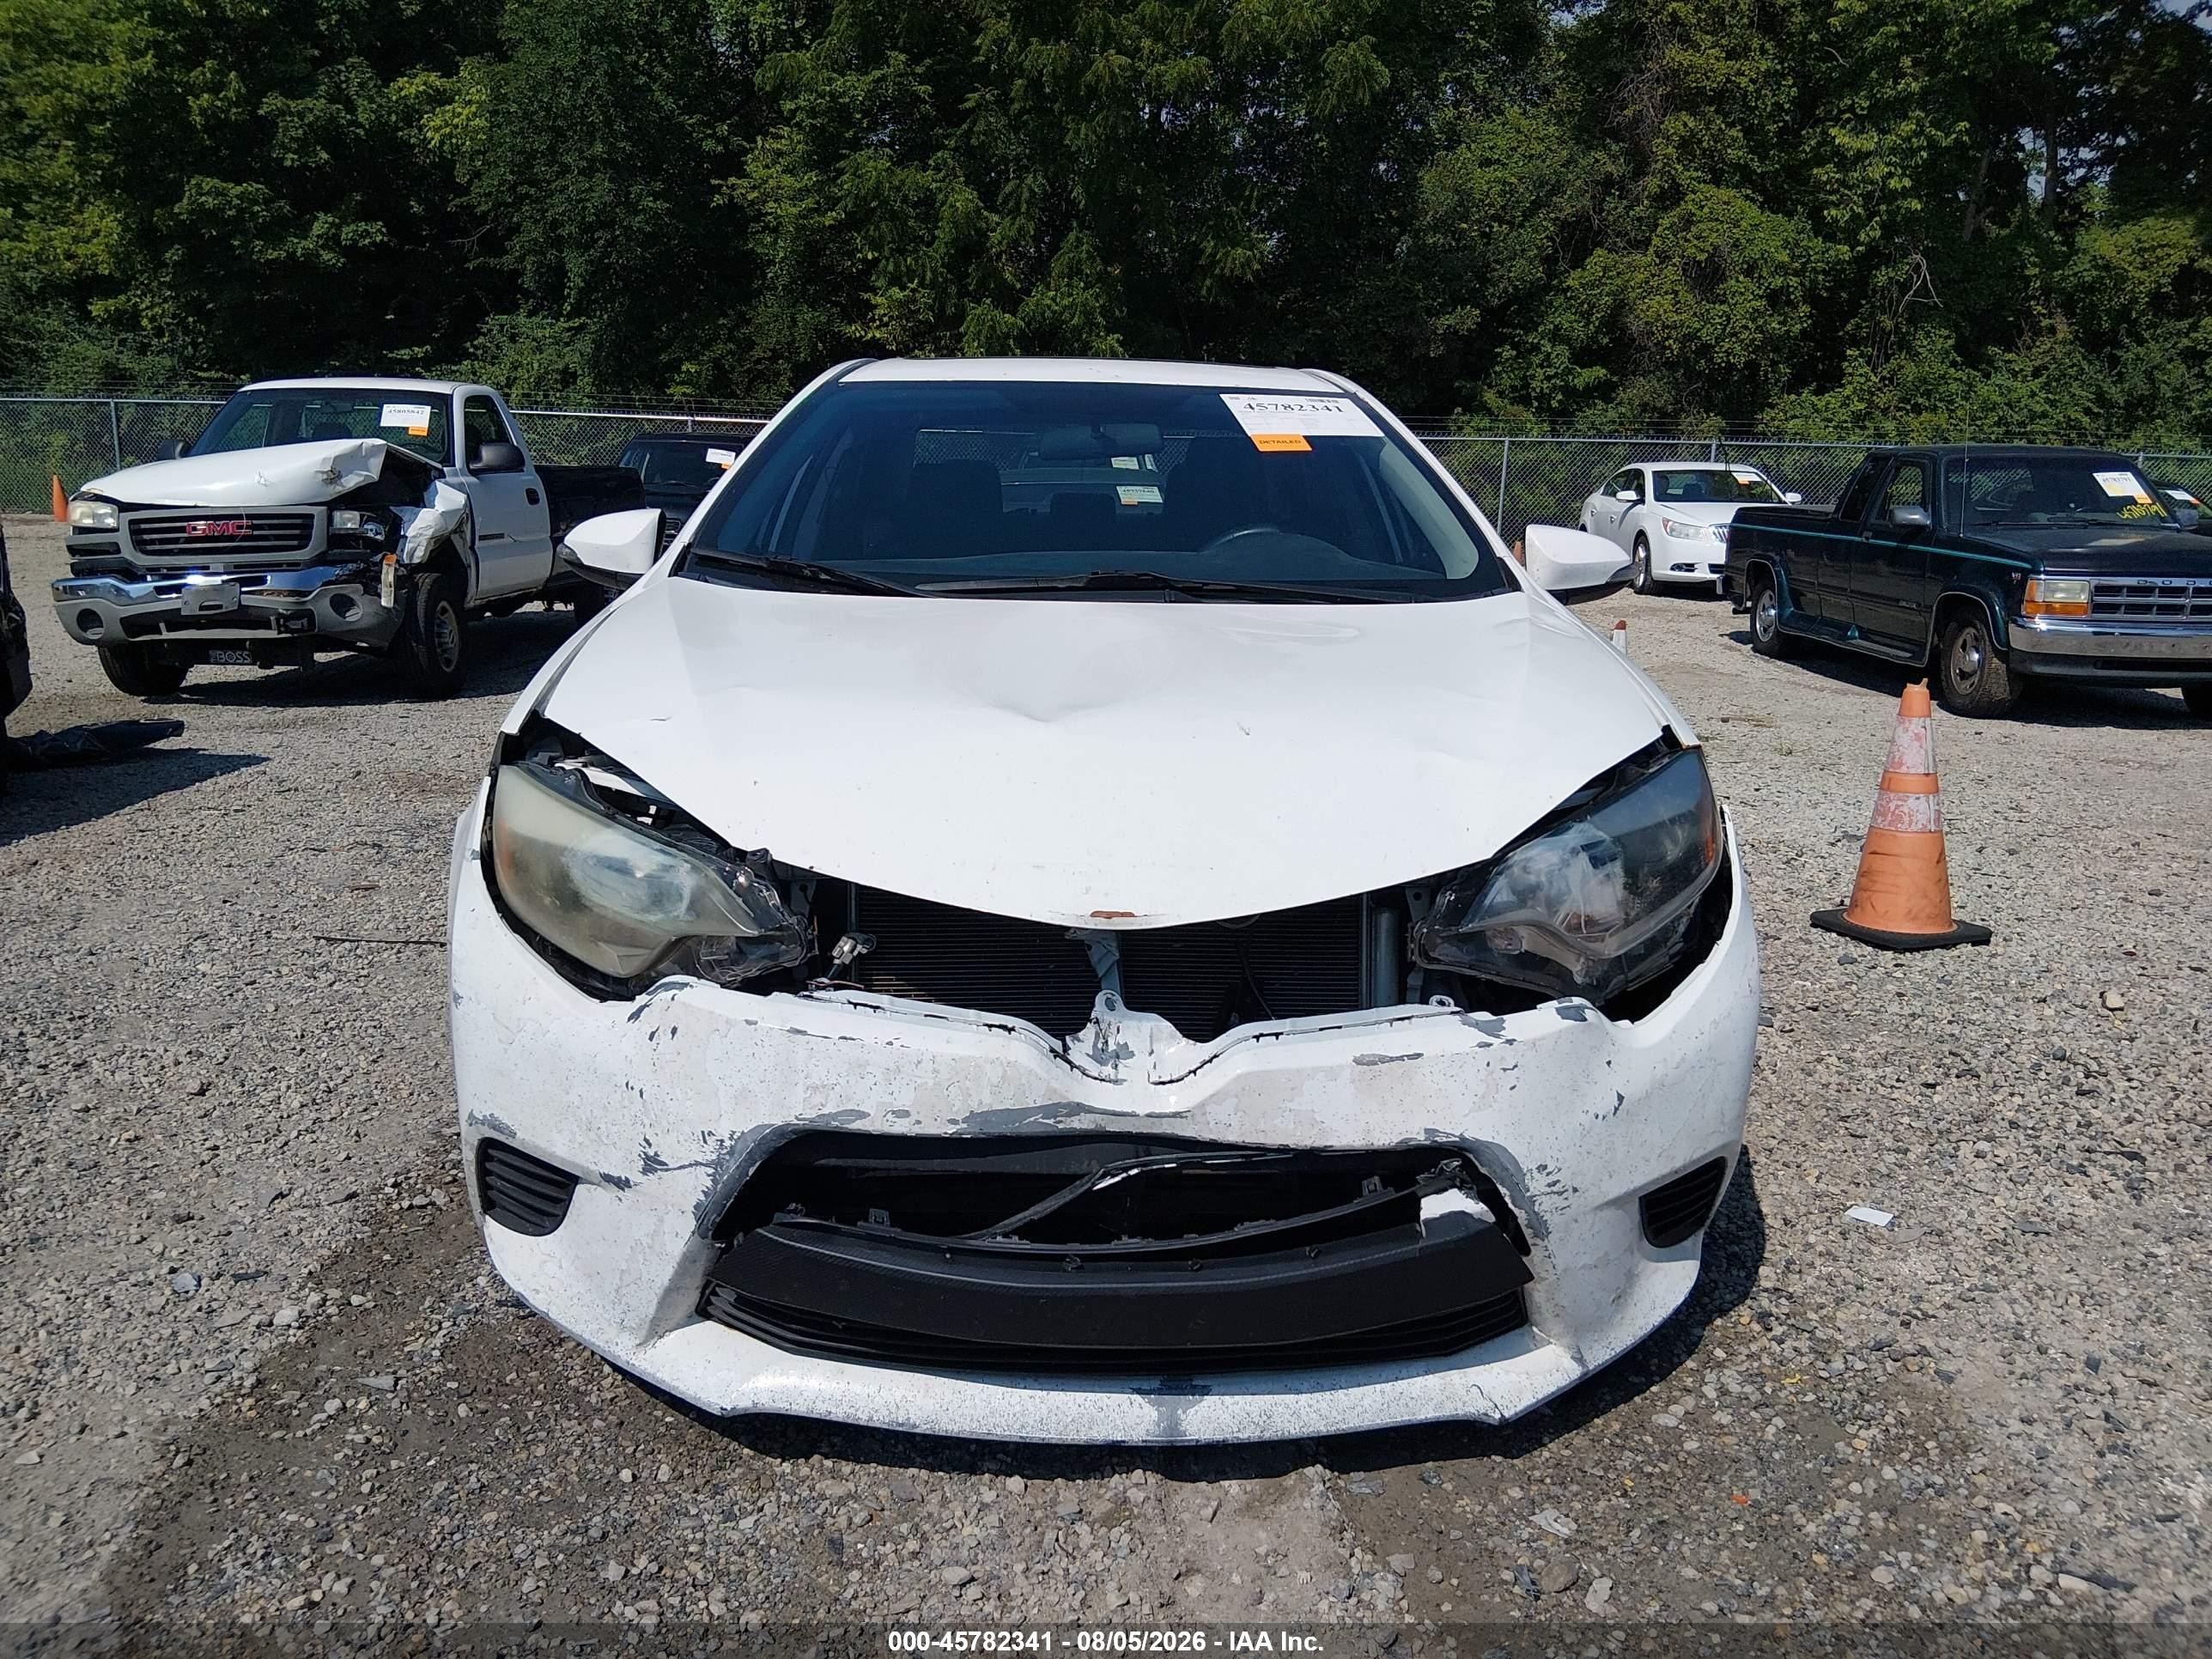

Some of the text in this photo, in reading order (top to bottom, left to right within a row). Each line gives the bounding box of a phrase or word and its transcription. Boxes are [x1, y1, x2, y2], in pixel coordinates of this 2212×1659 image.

[1243, 402, 1345, 413] 45782341
[185, 520, 252, 536] GMC
[216, 651, 251, 663] BOSS
